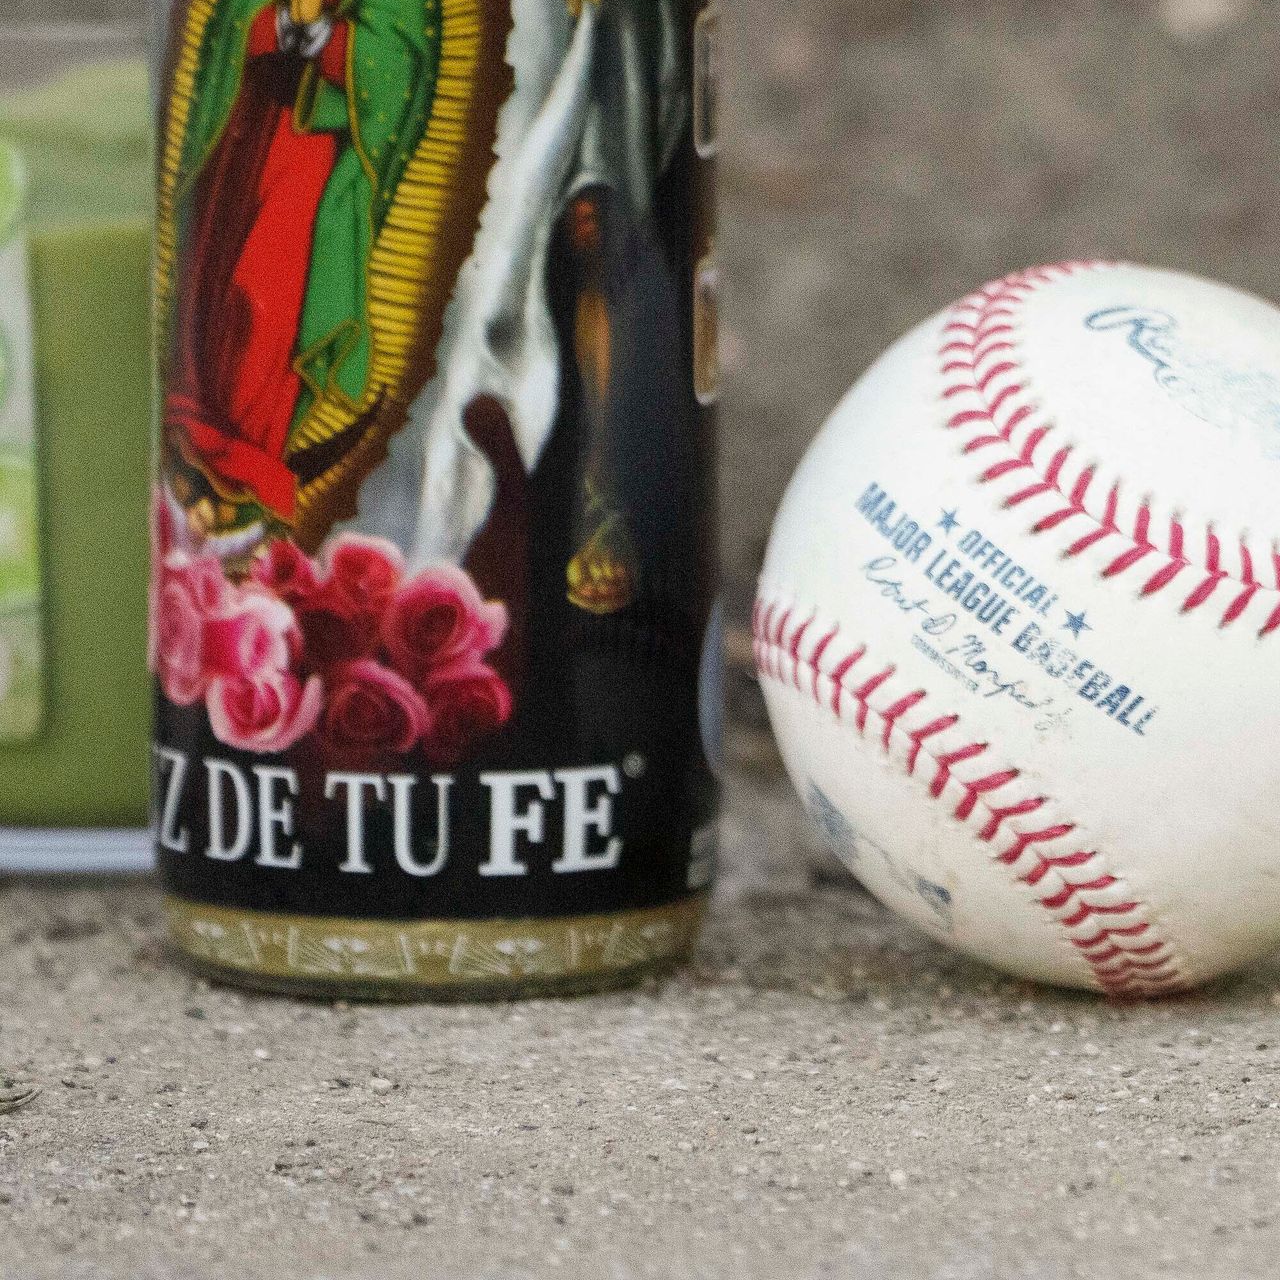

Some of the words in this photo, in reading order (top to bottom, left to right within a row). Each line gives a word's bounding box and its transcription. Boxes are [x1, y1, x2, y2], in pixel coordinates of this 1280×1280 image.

[854, 481, 932, 563] MAJOR
[923, 549, 1019, 636] LEAGUE
[1011, 621, 1160, 737] BASEBALL
[956, 529, 1059, 615] OFFICIAL
[204, 759, 301, 869] DE
[324, 772, 455, 877] TU
